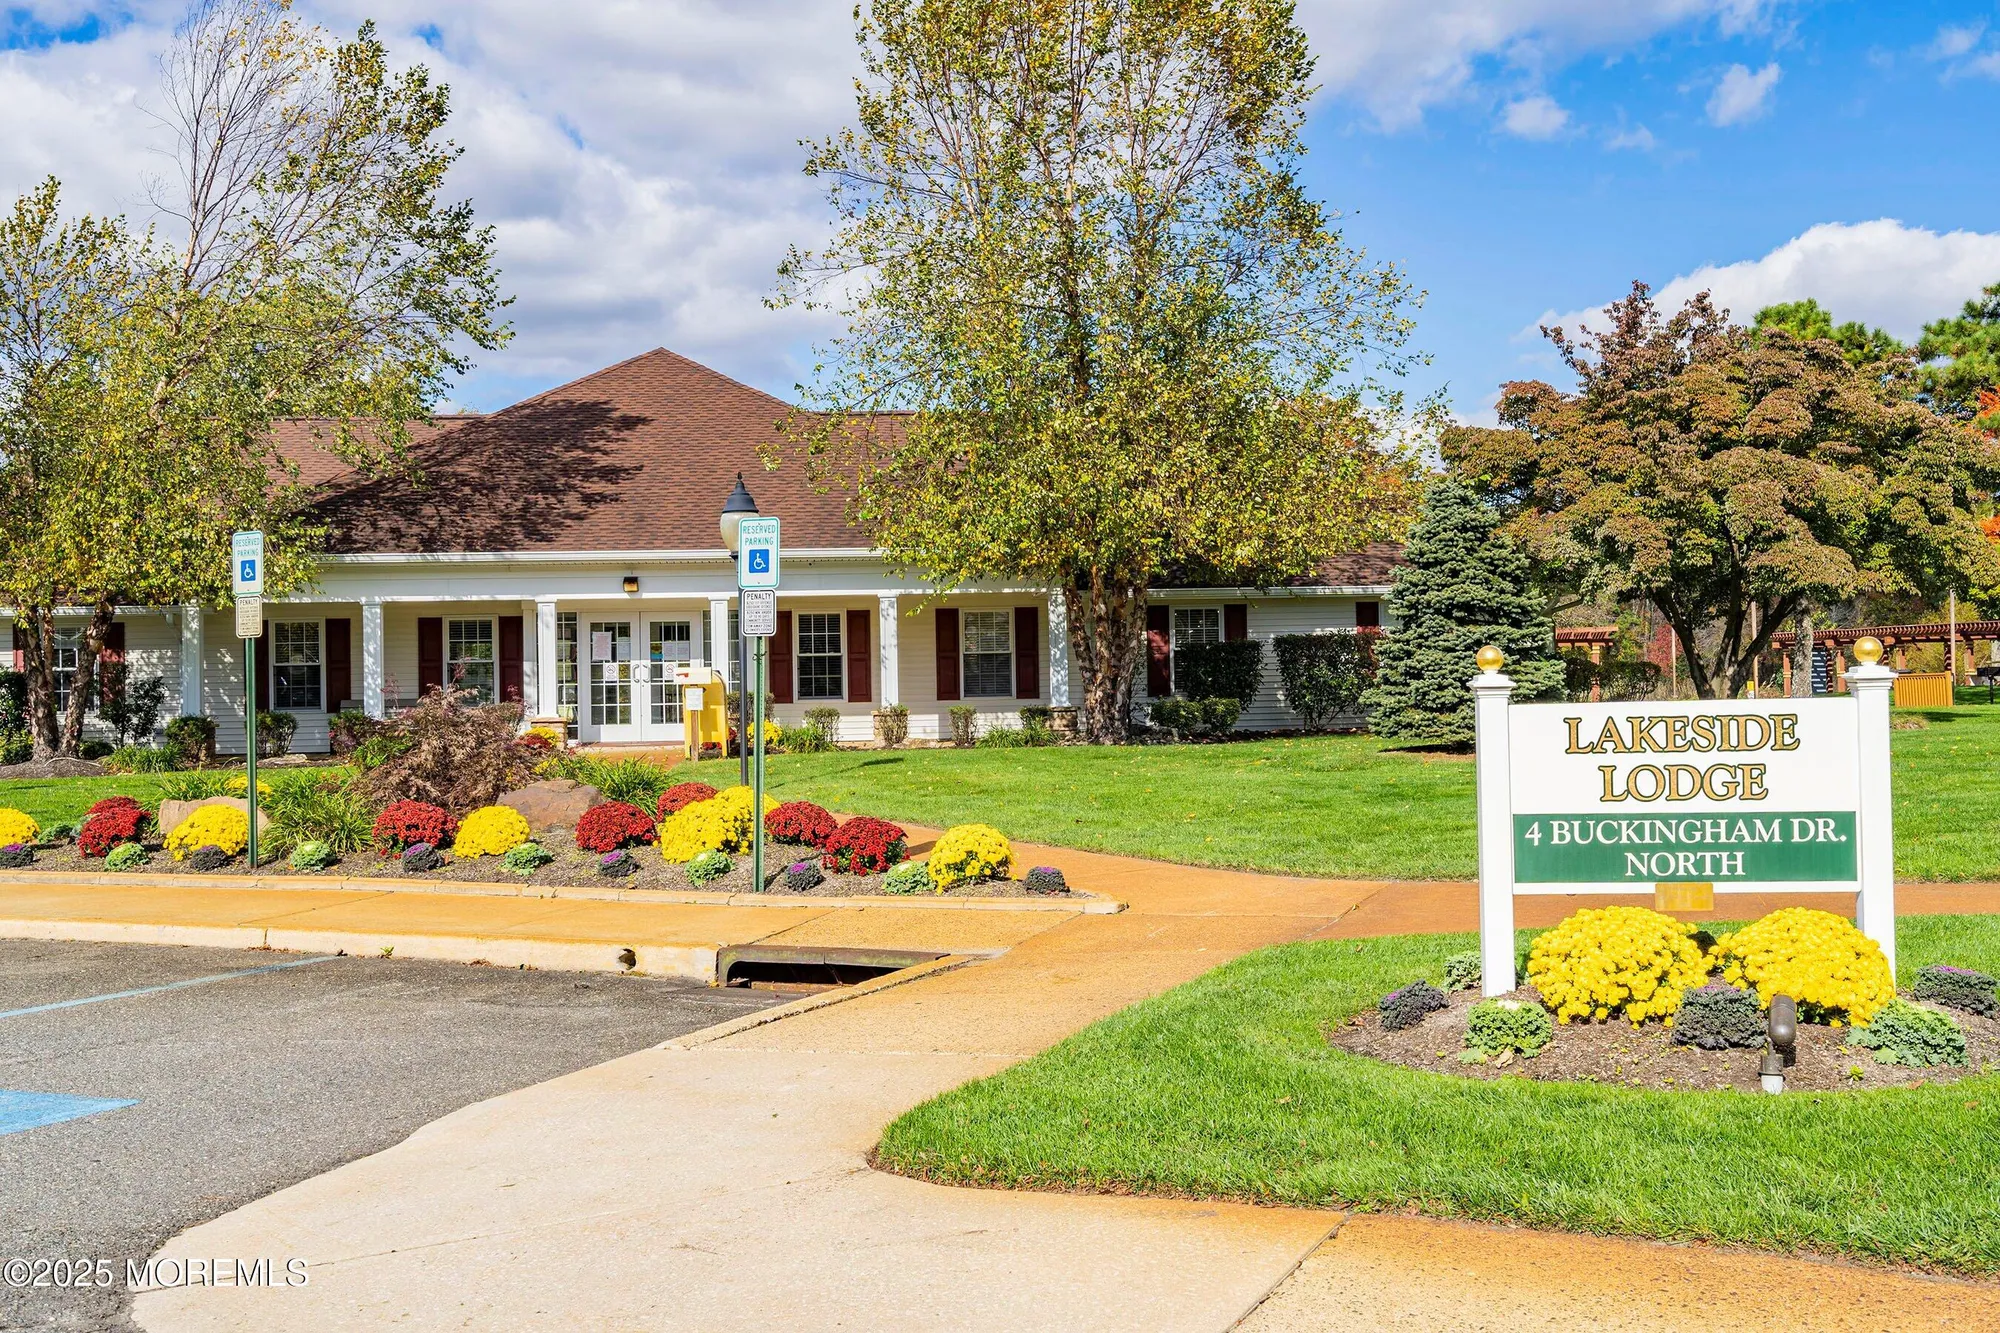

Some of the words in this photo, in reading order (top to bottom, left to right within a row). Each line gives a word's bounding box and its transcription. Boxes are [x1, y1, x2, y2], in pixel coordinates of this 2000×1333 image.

[742, 525, 776, 534] RESERVED
[235, 538, 260, 547] RESERVED
[745, 537, 774, 546] PARKING
[237, 549, 259, 557] PARKING
[1563, 713, 1801, 754] LAKESIDE
[1598, 763, 1769, 803] LODGE
[1524, 822, 1542, 847] 4
[1550, 818, 1783, 846] BUCKINGHAM
[1789, 818, 1848, 843] DR.
[1624, 851, 1747, 878] NORTH
